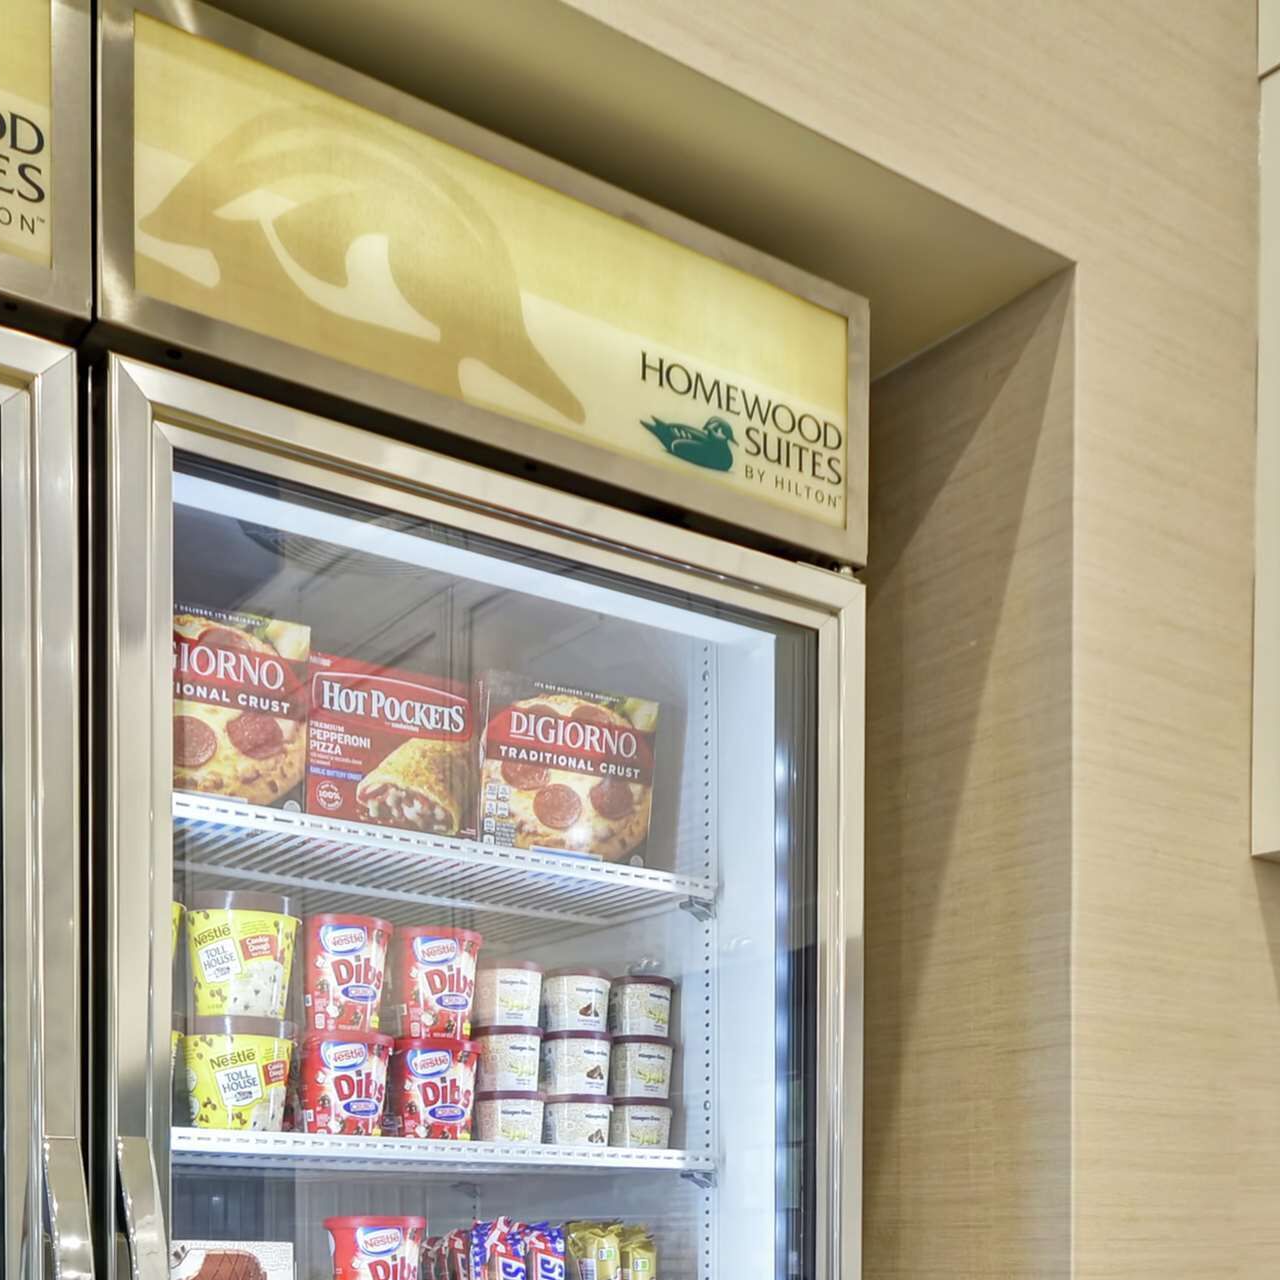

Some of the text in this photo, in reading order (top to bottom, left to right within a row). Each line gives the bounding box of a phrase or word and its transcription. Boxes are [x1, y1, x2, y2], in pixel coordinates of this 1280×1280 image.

[641, 351, 842, 450] HOMEWOOD
[745, 427, 842, 485] SUITES
[745, 465, 837, 508] BY HILTON
[238, 693, 291, 714] CRUST
[322, 679, 467, 734] HOT POCKETS
[310, 728, 371, 749] PEPPERONI
[310, 740, 342, 756] PIZZA
[510, 711, 638, 758] DIGIORNO
[499, 745, 641, 779] TRADITIONAL CRUST
[203, 952, 237, 971] HOUSE
[204, 945, 227, 959] TOLL
[330, 955, 384, 989] Dibs
[425, 965, 475, 996] Dibs
[221, 1077, 259, 1095] HOUSE
[224, 1070, 252, 1085] TOLL
[333, 1070, 384, 1103] Dibs
[419, 1076, 472, 1108] Dibs
